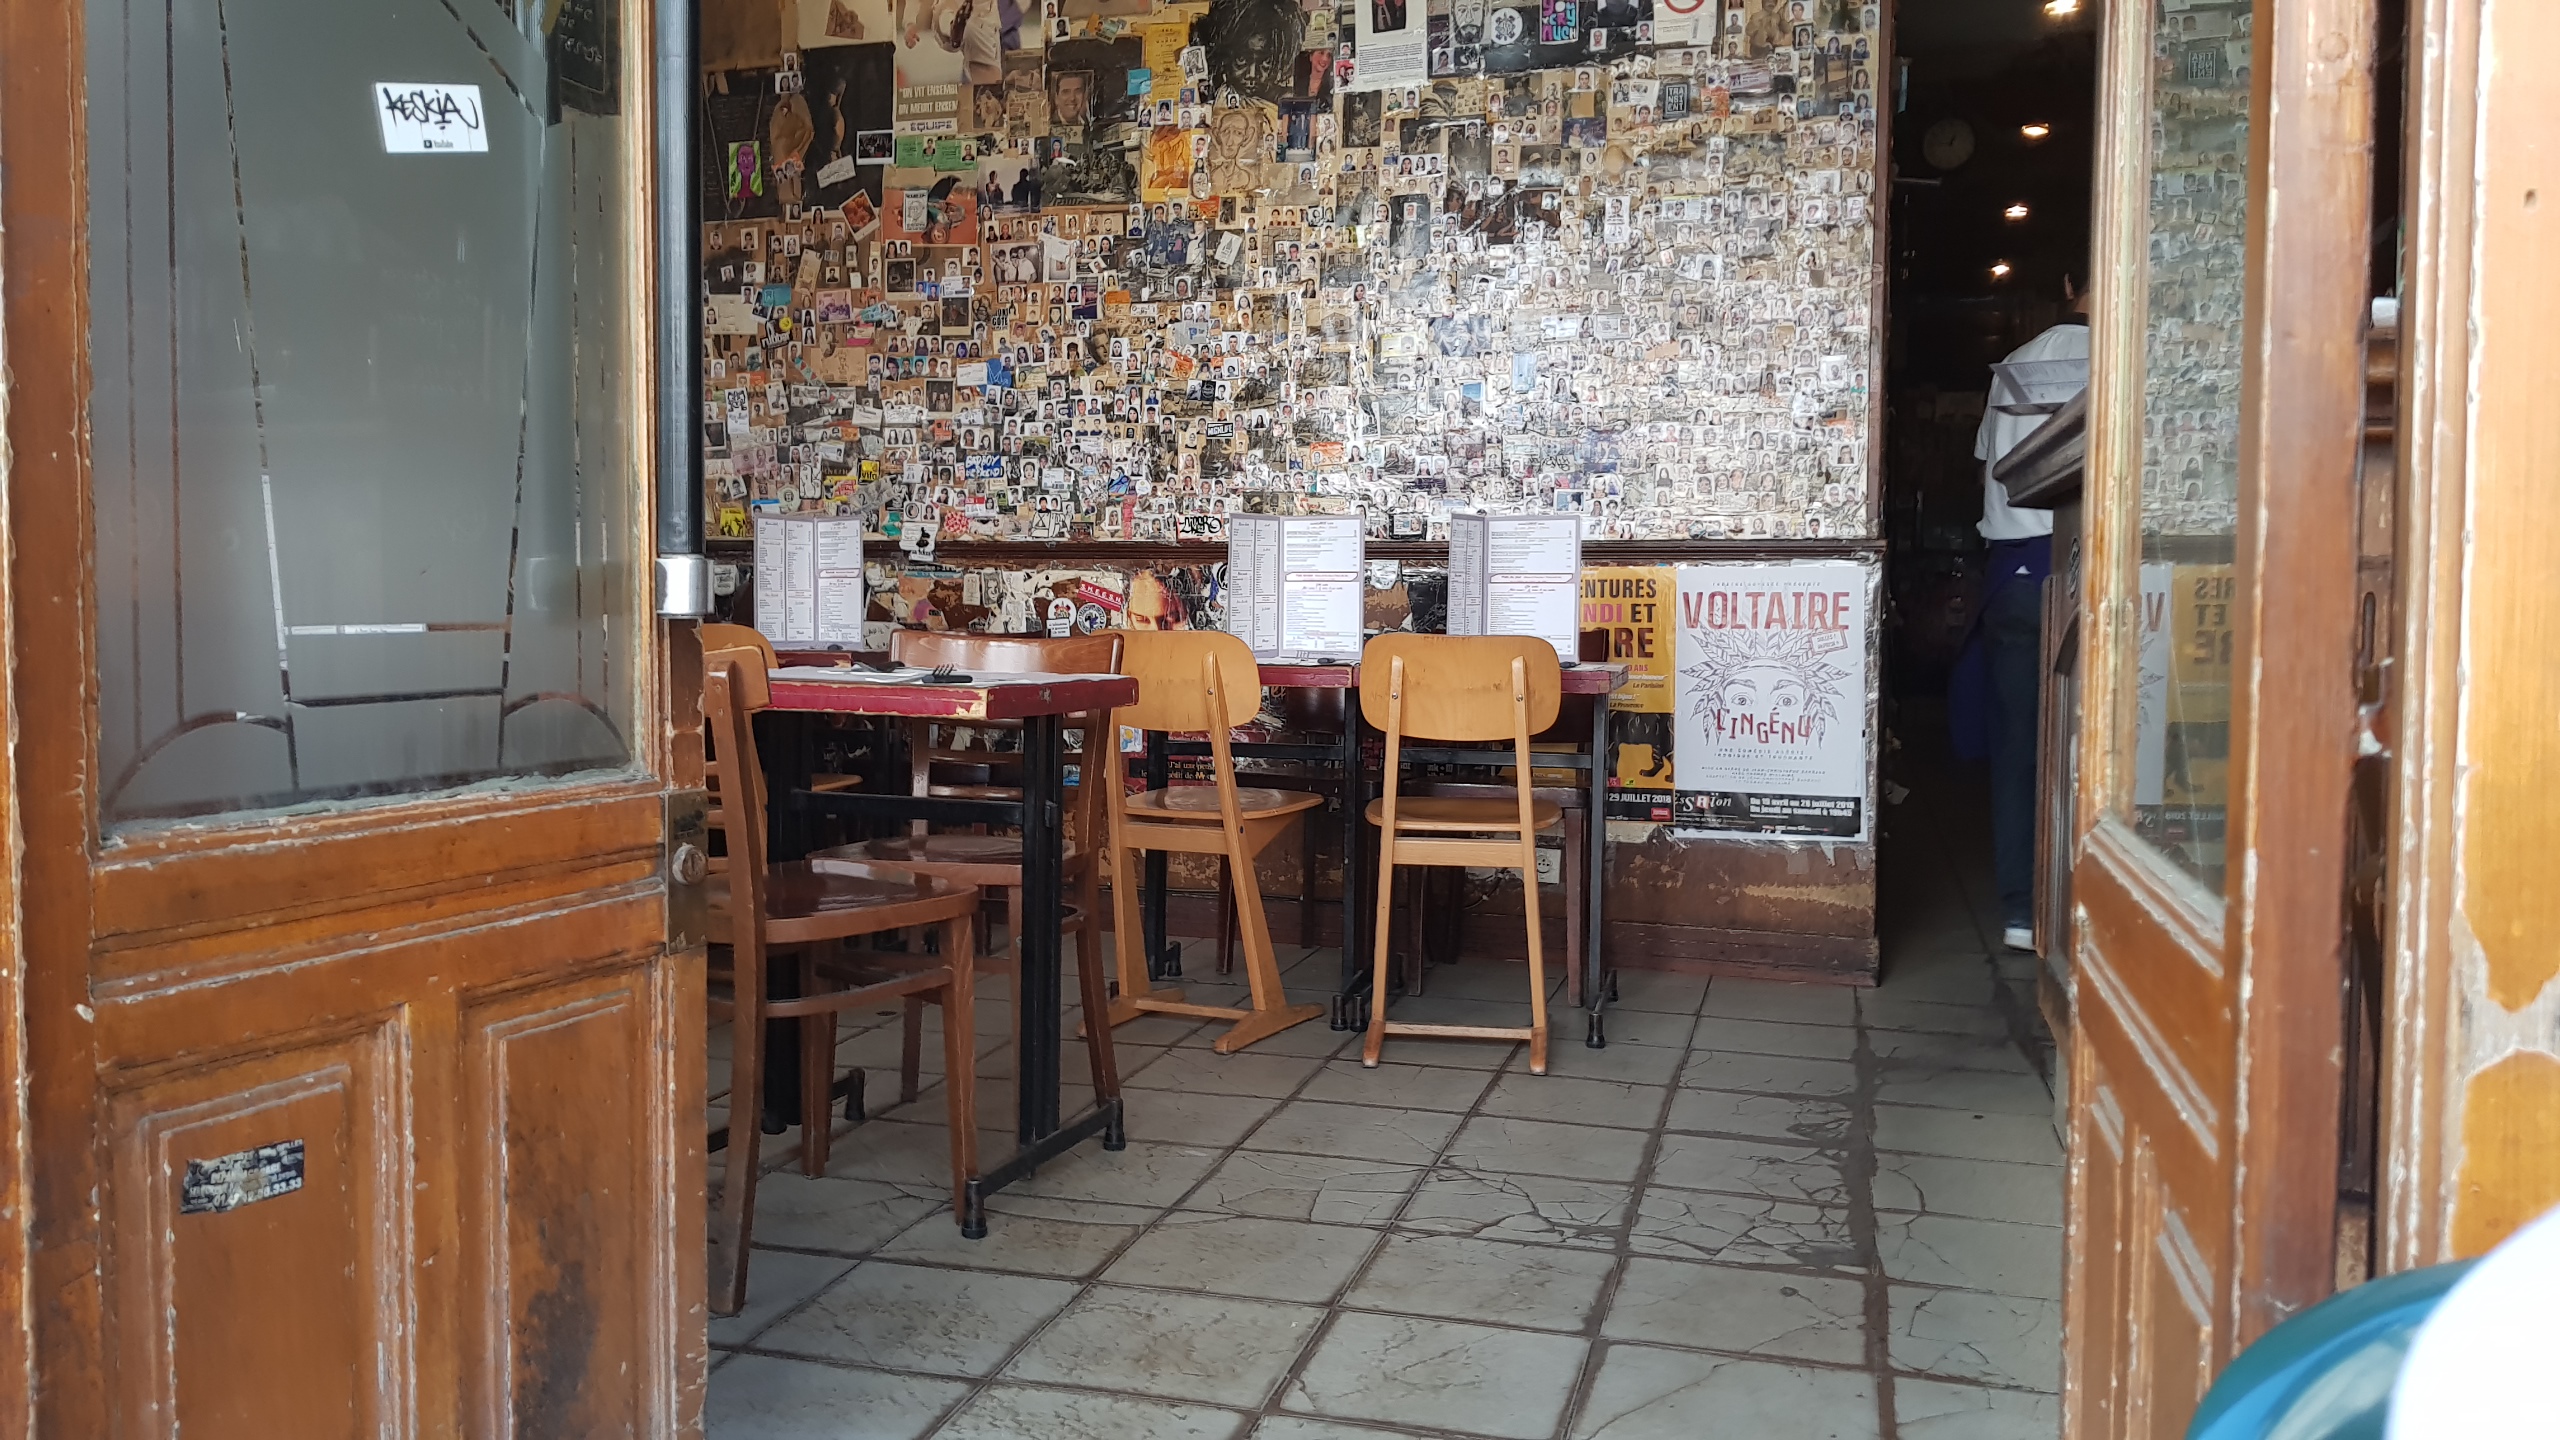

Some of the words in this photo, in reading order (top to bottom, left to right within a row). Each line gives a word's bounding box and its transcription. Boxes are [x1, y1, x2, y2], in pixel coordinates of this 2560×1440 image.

[1630, 603, 1657, 623] ET
[1682, 591, 1850, 630] VOLTAIRE
[1634, 664, 1649, 672] ANS
[1717, 707, 1811, 745] L'INGÉNU
[1608, 793, 1620, 802] 29
[1620, 793, 1651, 803] JUILLET
[1651, 794, 1672, 804] 2018
